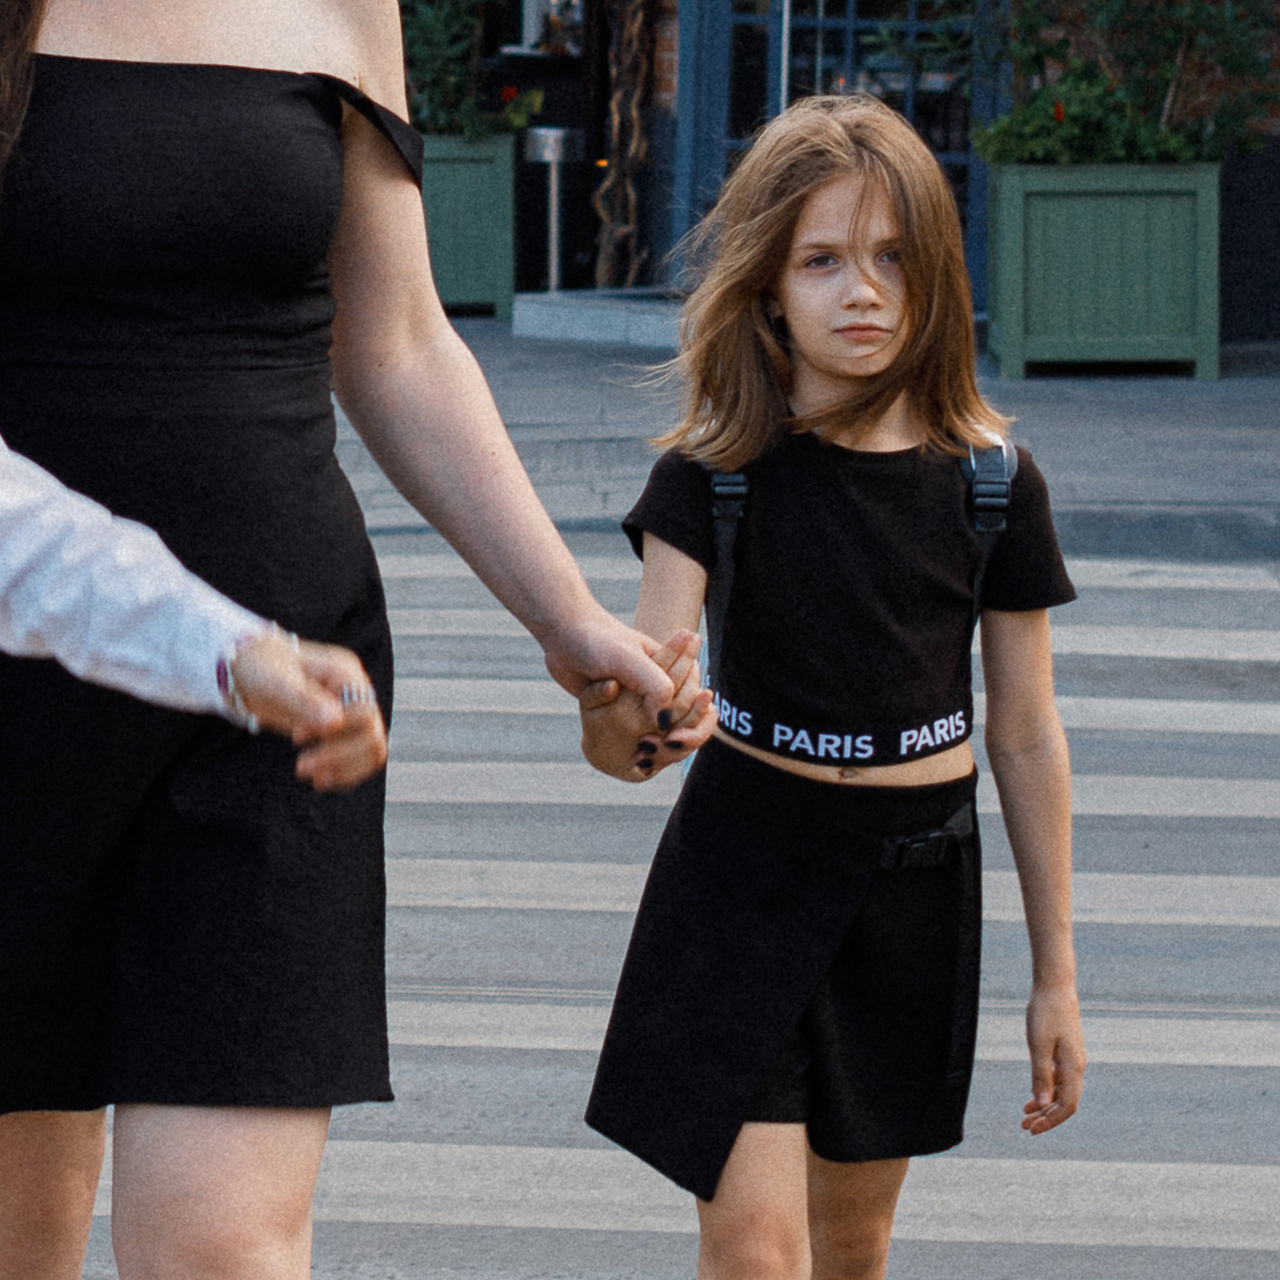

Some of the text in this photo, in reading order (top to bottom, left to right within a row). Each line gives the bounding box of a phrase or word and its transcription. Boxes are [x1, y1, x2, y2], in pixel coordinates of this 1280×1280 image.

[712, 690, 966, 759] ARIS PARIS PARIS
